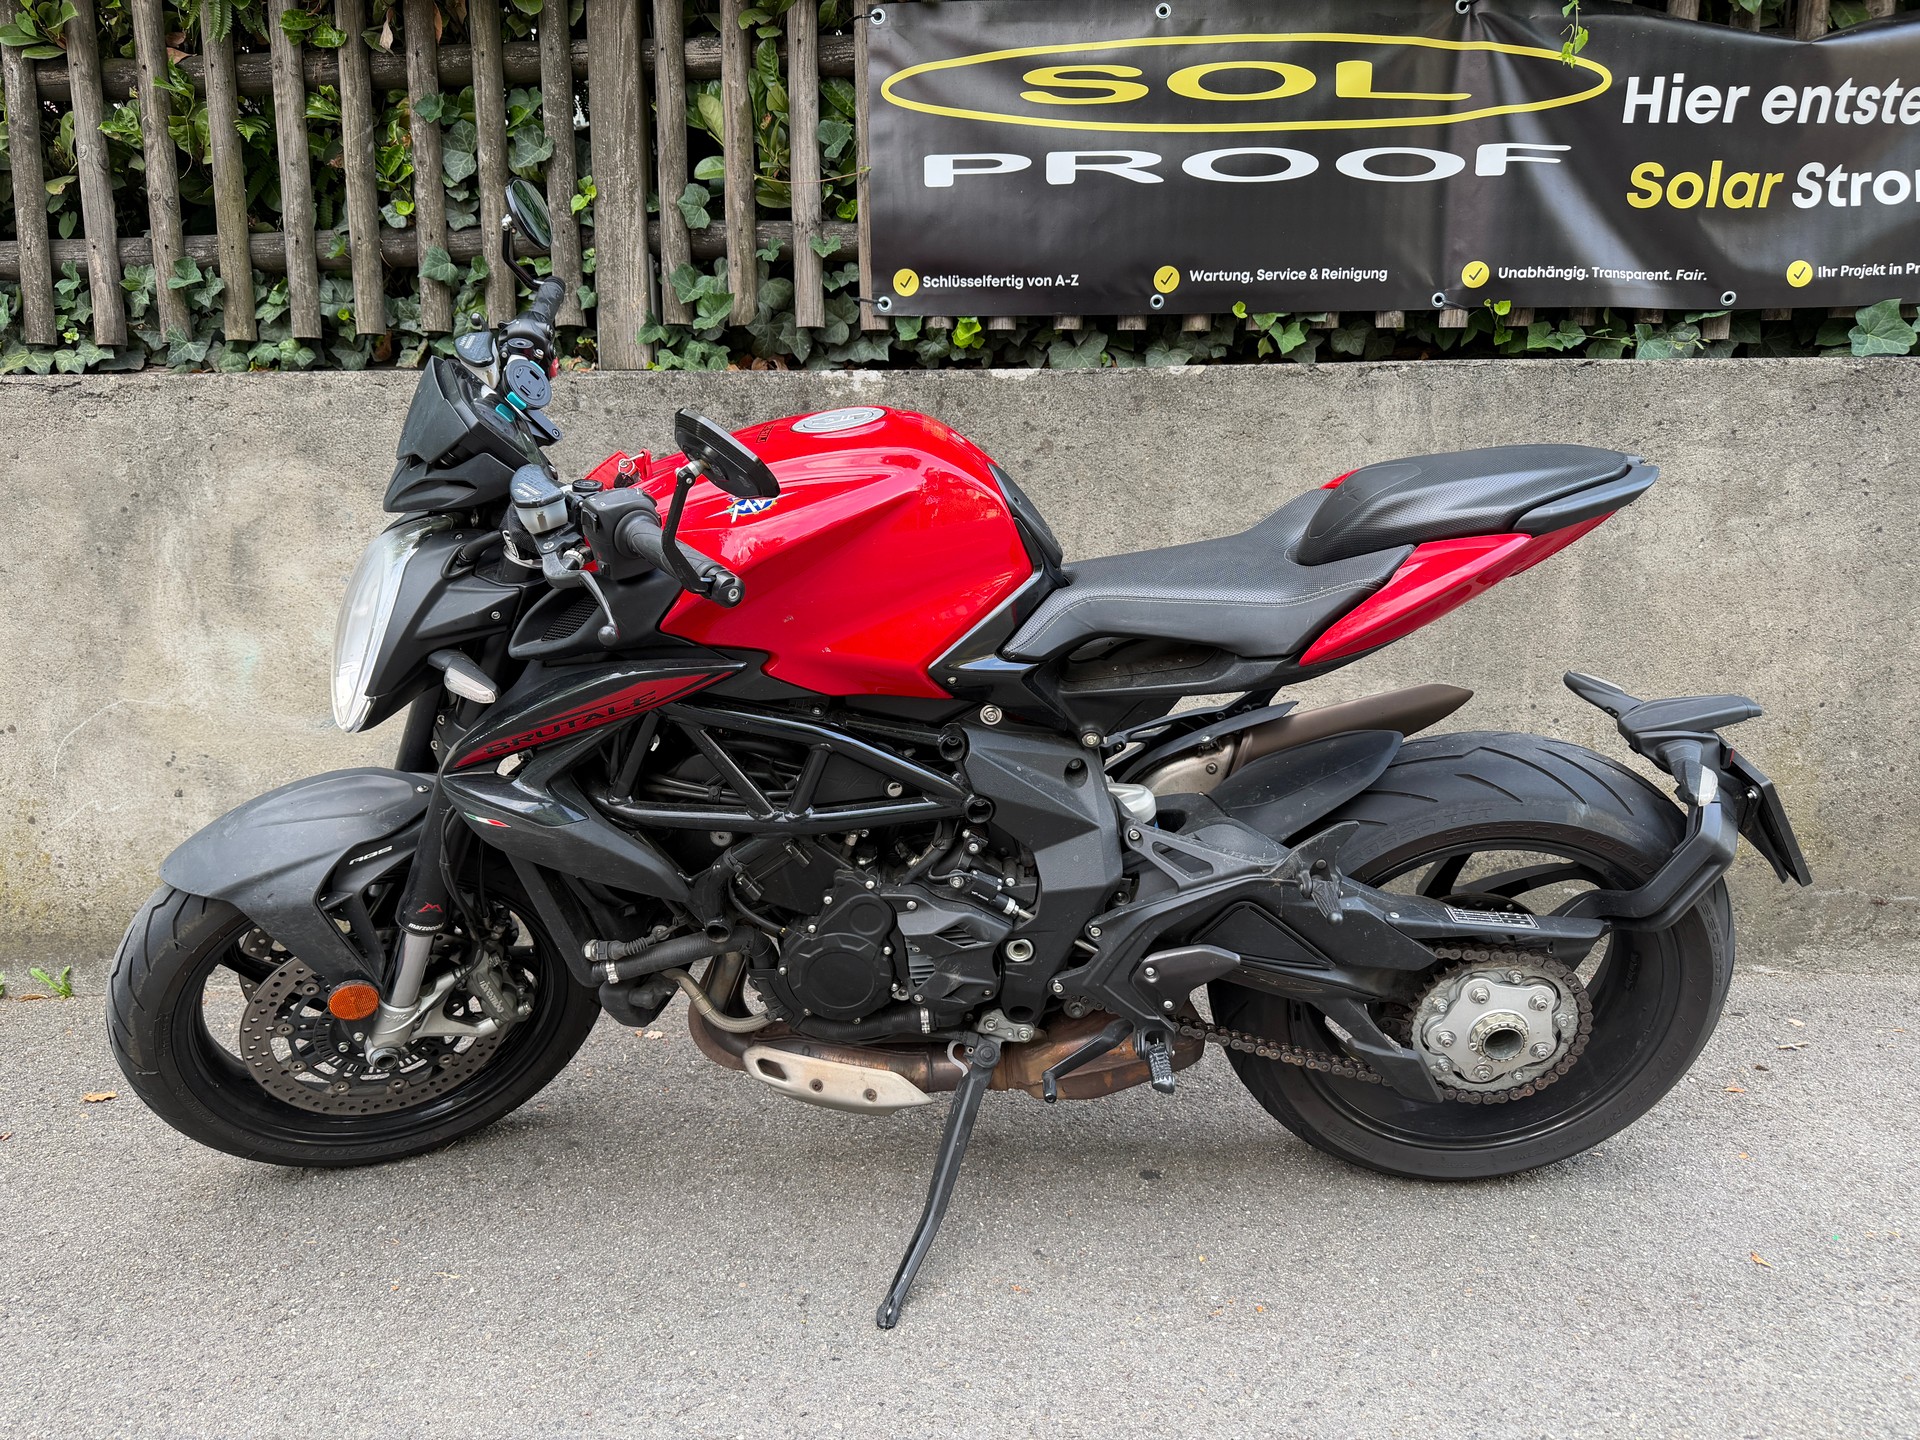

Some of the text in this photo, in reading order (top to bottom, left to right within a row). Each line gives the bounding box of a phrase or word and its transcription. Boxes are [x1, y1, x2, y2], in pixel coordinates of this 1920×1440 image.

[1020, 60, 1472, 105] SOL
[1622, 73, 1920, 125] Hier entste
[924, 143, 1572, 188] PROOF
[1626, 160, 1920, 209] Solar Stro
[922, 274, 1079, 290] Schlüsselfertig von A-Z
[1189, 267, 1388, 284] Wartung, Service & Reinigung
[1498, 266, 1708, 282] Unabhängig. Transparent. Fair.
[1818, 265, 1838, 278] Ihr
[1840, 264, 1886, 280] Projekt
[1888, 262, 1902, 276] in
[485, 690, 657, 754] BRUTALE
[349, 845, 393, 866] ABS
